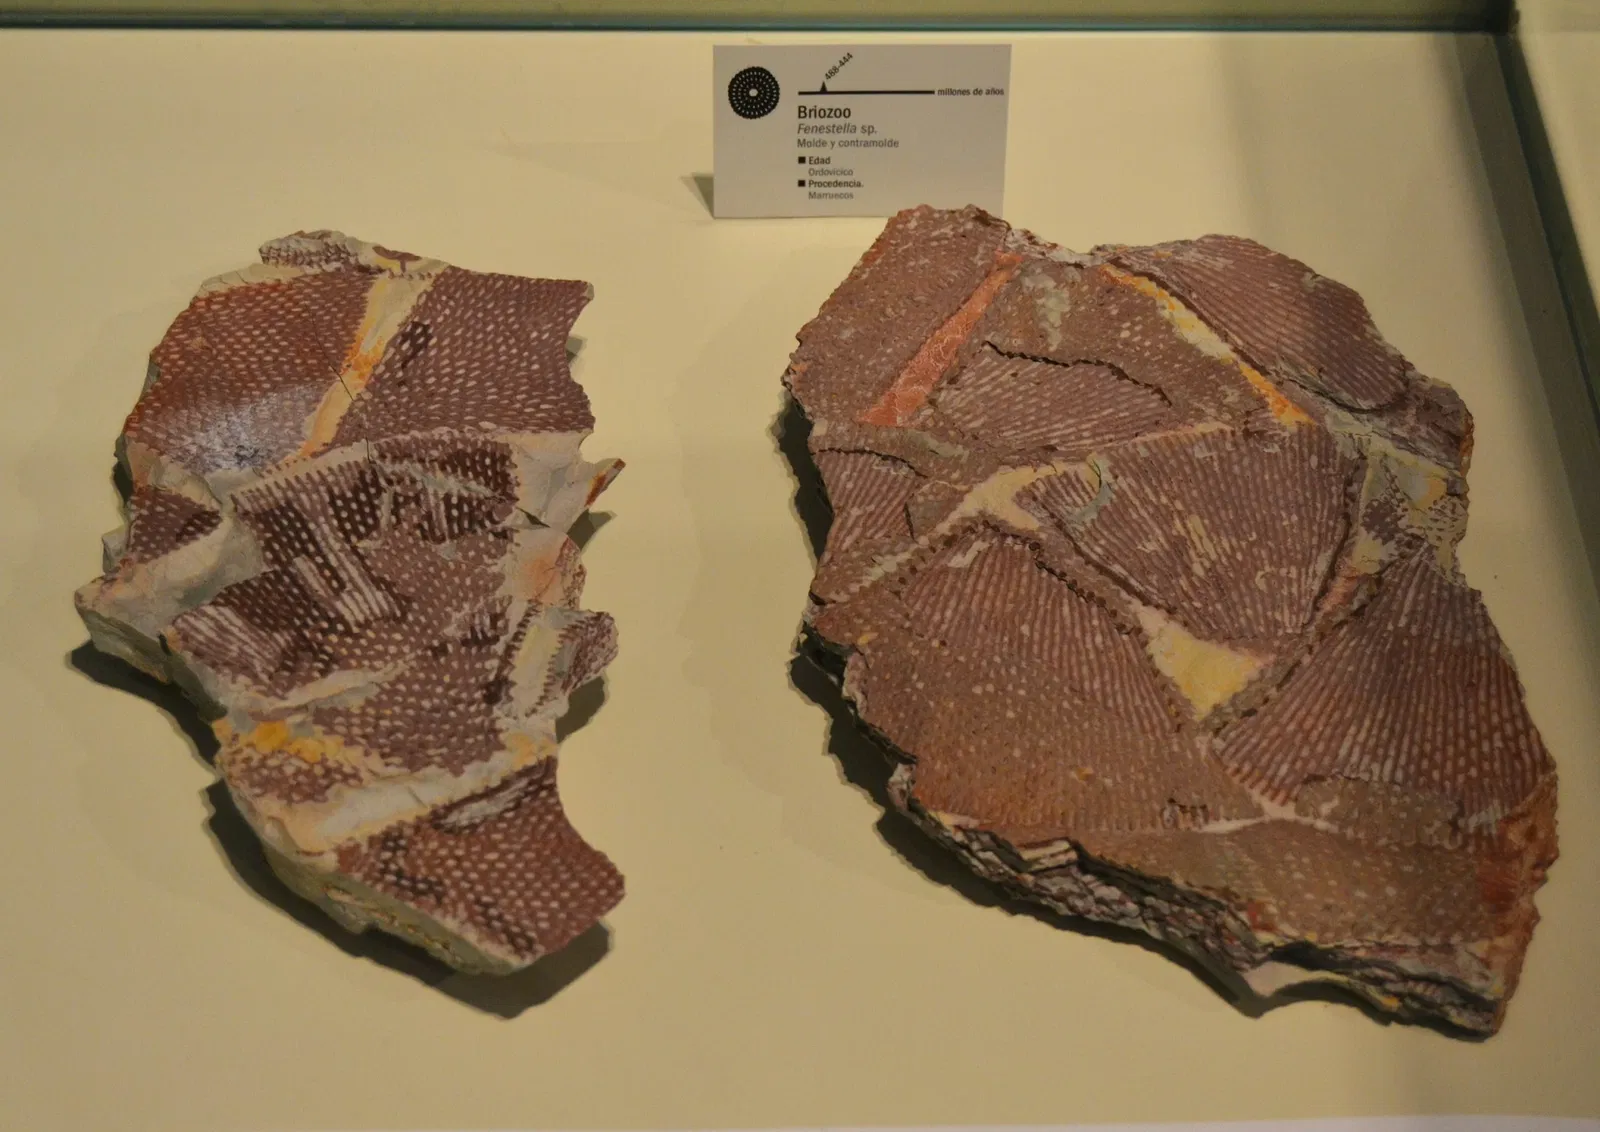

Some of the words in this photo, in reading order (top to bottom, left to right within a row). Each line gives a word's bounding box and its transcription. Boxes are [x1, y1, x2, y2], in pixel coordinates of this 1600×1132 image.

[824, 52, 853, 80] 488-444
[937, 88, 970, 96] millones
[973, 88, 983, 96] de
[985, 87, 1005, 96] años
[797, 105, 852, 119] Briozoo
[797, 122, 857, 134] Fenestella
[860, 125, 877, 136] sp.
[797, 138, 828, 148] Molde
[830, 140, 836, 150] y
[838, 138, 899, 148] contramolde
[808, 156, 831, 165] Edad
[808, 191, 854, 200] Marruecos
